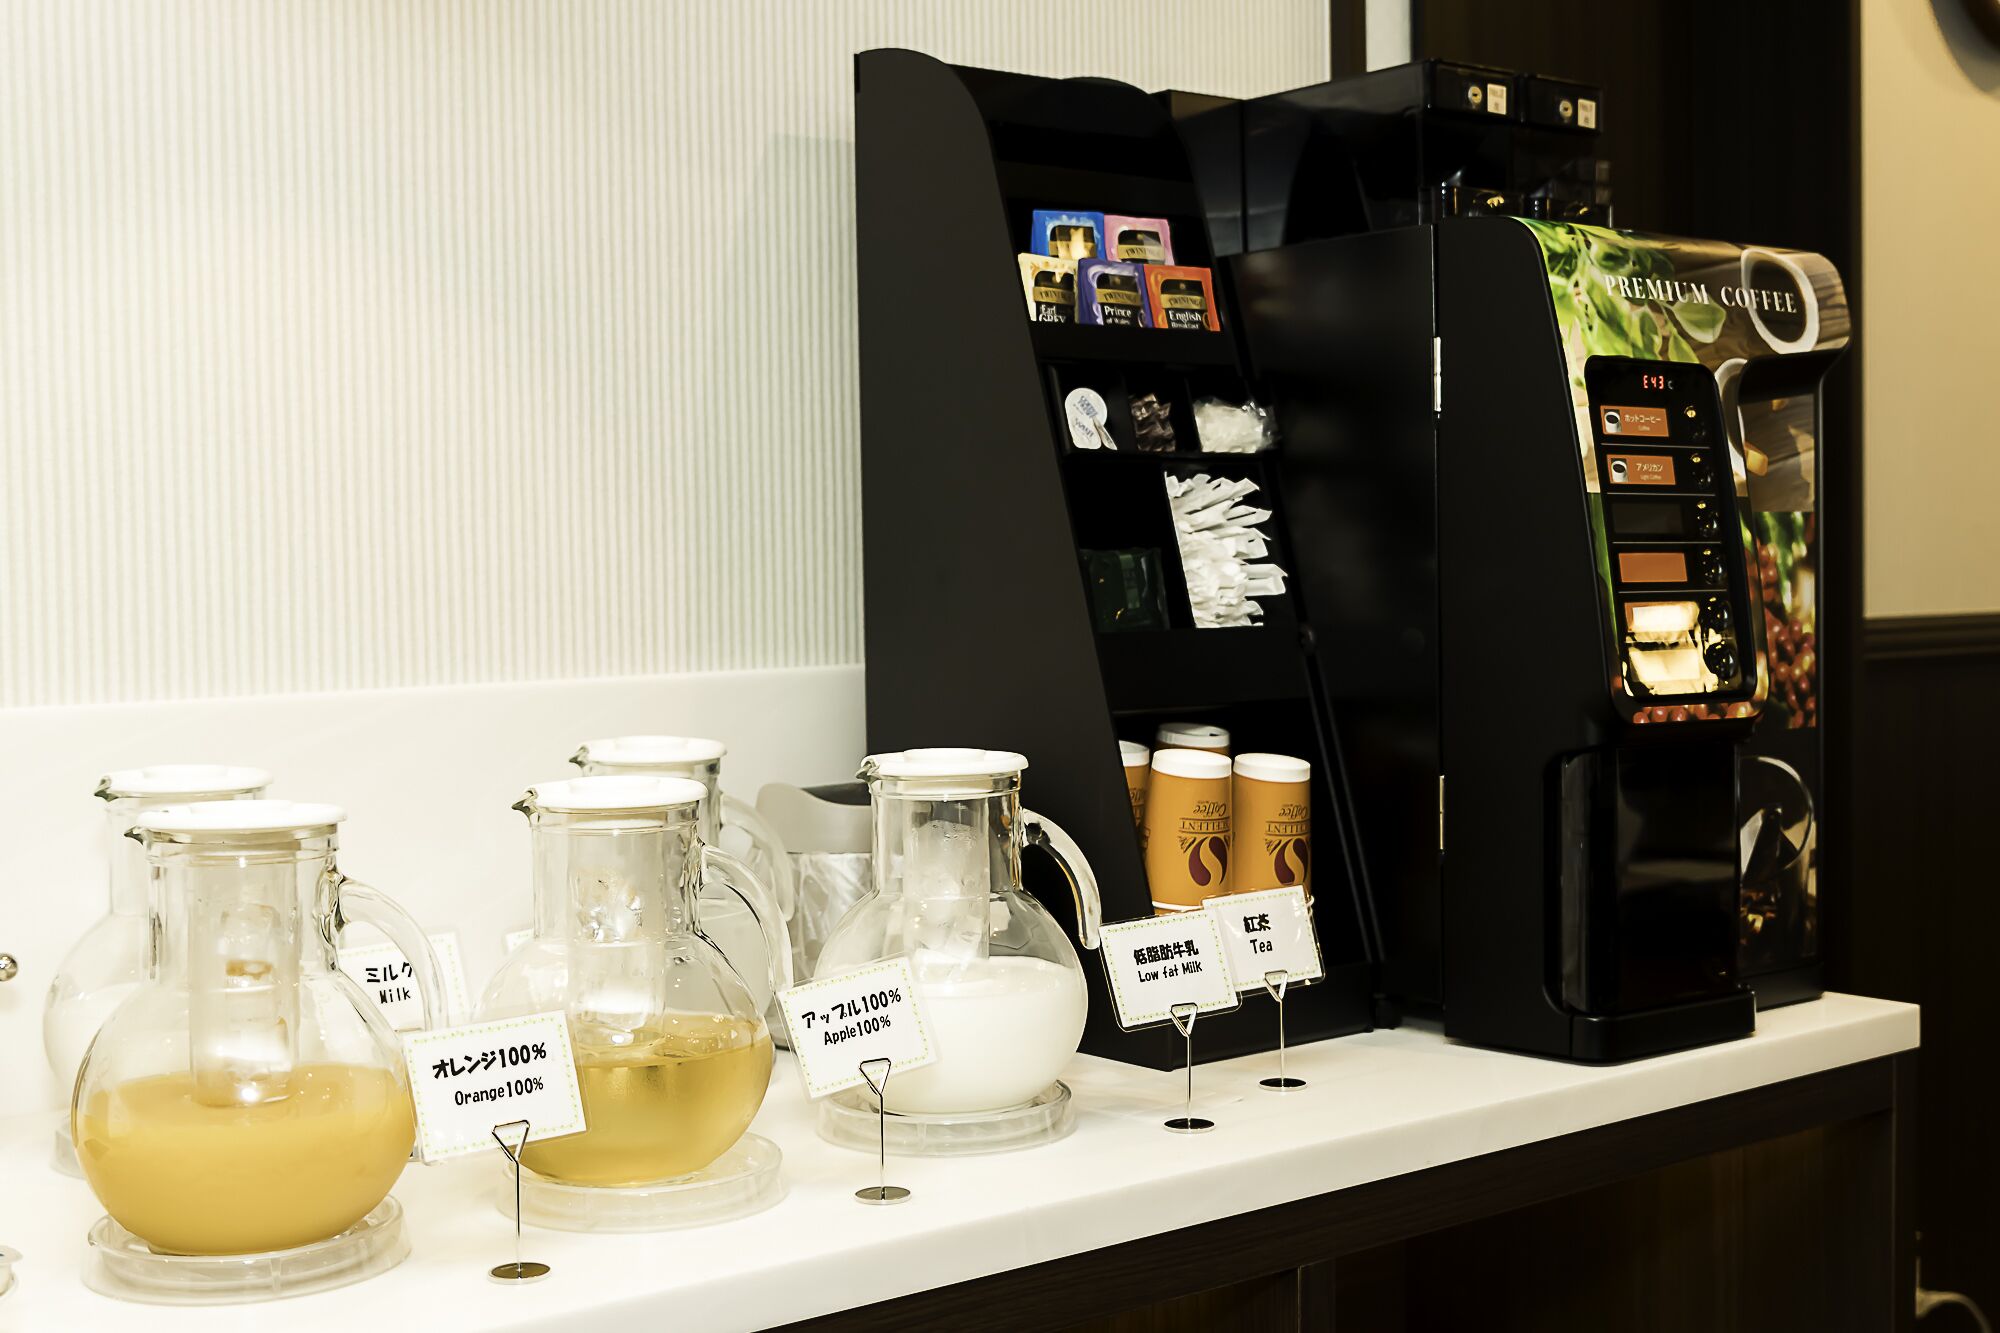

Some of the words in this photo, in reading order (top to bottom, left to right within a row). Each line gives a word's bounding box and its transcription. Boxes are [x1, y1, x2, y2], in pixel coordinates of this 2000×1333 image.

[1604, 274, 1710, 305] PREMIUM
[1720, 286, 1798, 314] COFFEE
[1103, 305, 1132, 318] Prince
[1168, 309, 1202, 324] English
[1624, 414, 1662, 424] ホットコーヒー
[1635, 463, 1663, 472] アメリカン
[1192, 802, 1227, 817] Coffee
[1243, 913, 1271, 934] 紅茶
[1133, 939, 1200, 966] 低脂肪牛乳
[1249, 938, 1273, 954] Tea
[365, 961, 414, 983] ミルク
[1138, 968, 1159, 983] Low
[1162, 965, 1179, 979] fat
[1182, 960, 1203, 974] Milk
[379, 986, 412, 1004] Milk
[801, 987, 902, 1029] アップル100%
[432, 1042, 547, 1080] オレンジ100%
[454, 1076, 544, 1107] Orange100%
